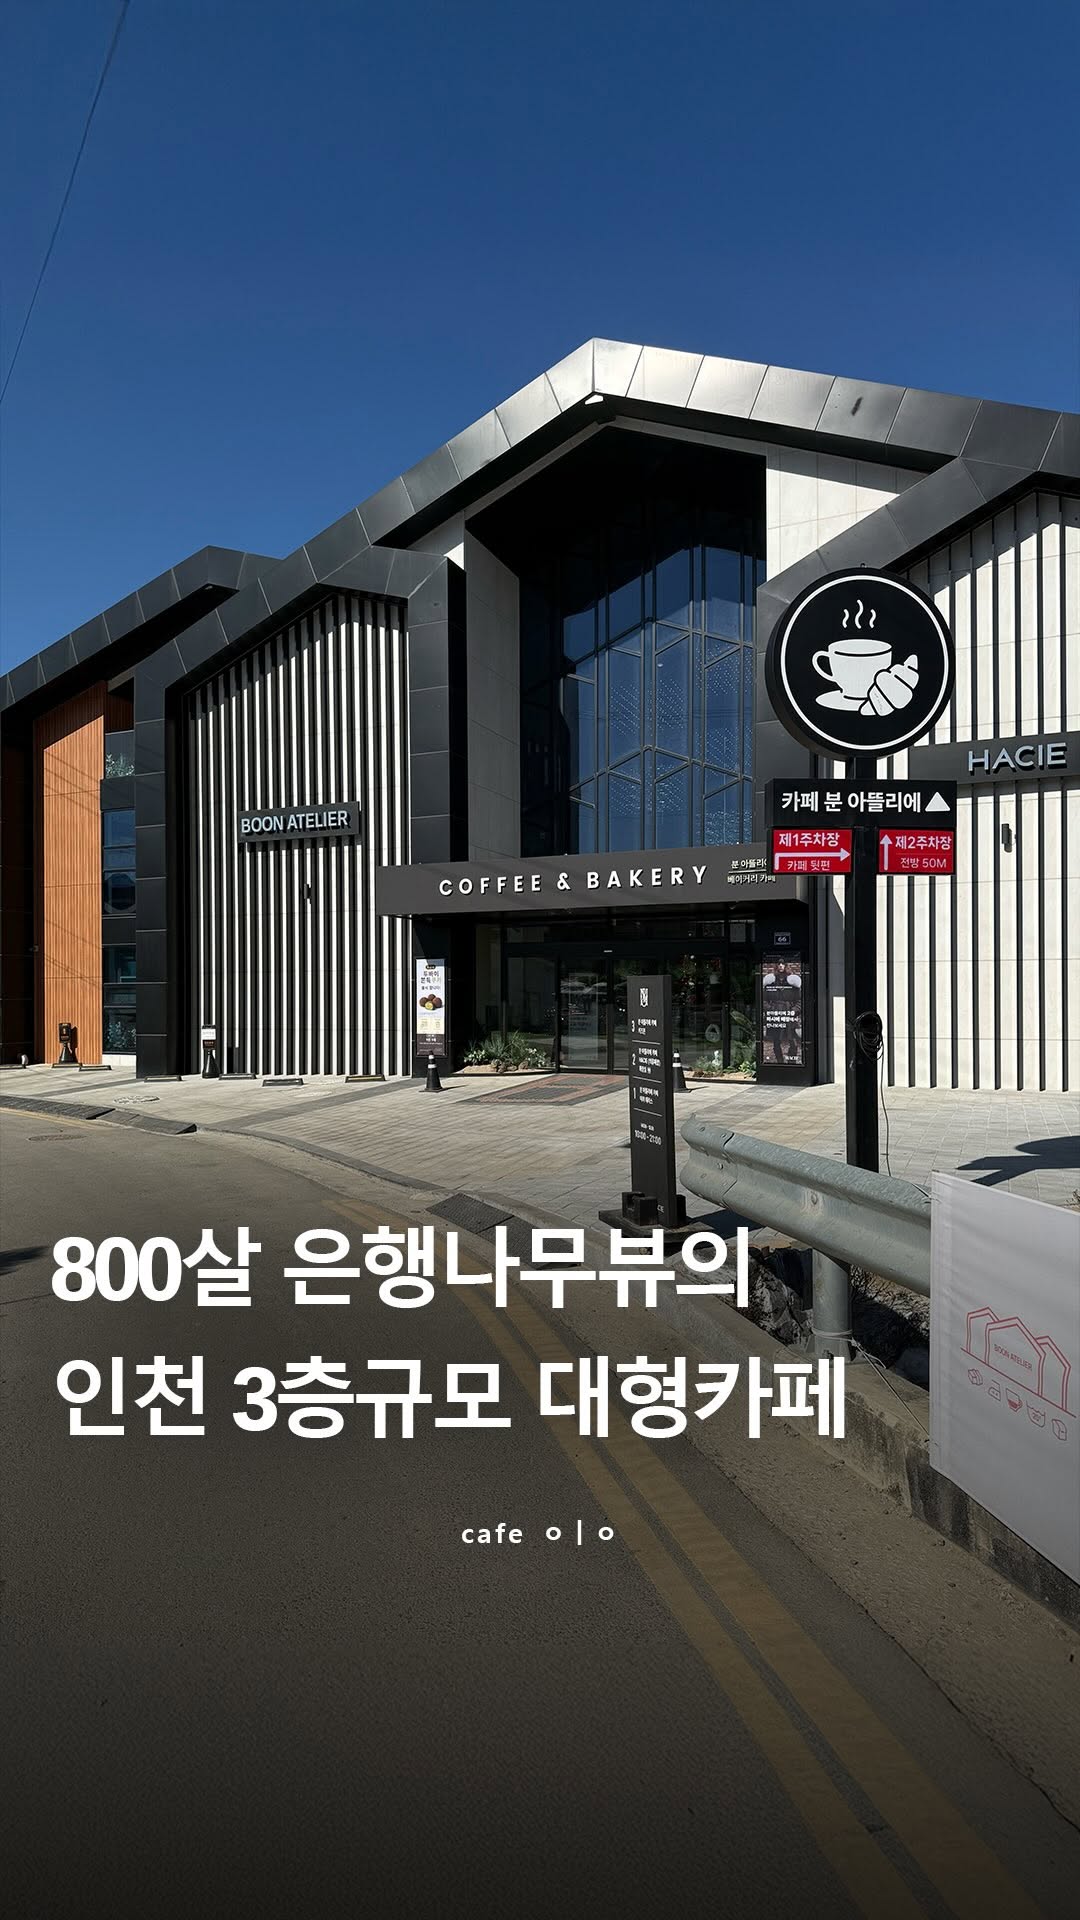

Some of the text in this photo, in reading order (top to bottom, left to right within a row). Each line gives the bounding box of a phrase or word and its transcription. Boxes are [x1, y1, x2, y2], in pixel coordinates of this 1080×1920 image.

[968, 742, 1066, 772] HACIE
[781, 791, 921, 813] 카페 분 아뜰리에
[241, 810, 349, 833] BOON ATELIER
[779, 832, 840, 848] 제1주차장
[895, 835, 952, 850] 제2주차장
[731, 860, 739, 869] 분
[787, 860, 831, 871] 카페 뒷편
[900, 857, 947, 869] 전방 50M
[439, 865, 707, 896] COFFEE & BAKERY
[727, 874, 758, 884] 베이커리
[631, 1020, 636, 1033] 3
[1010, 1352, 1033, 1371] ATELIER
